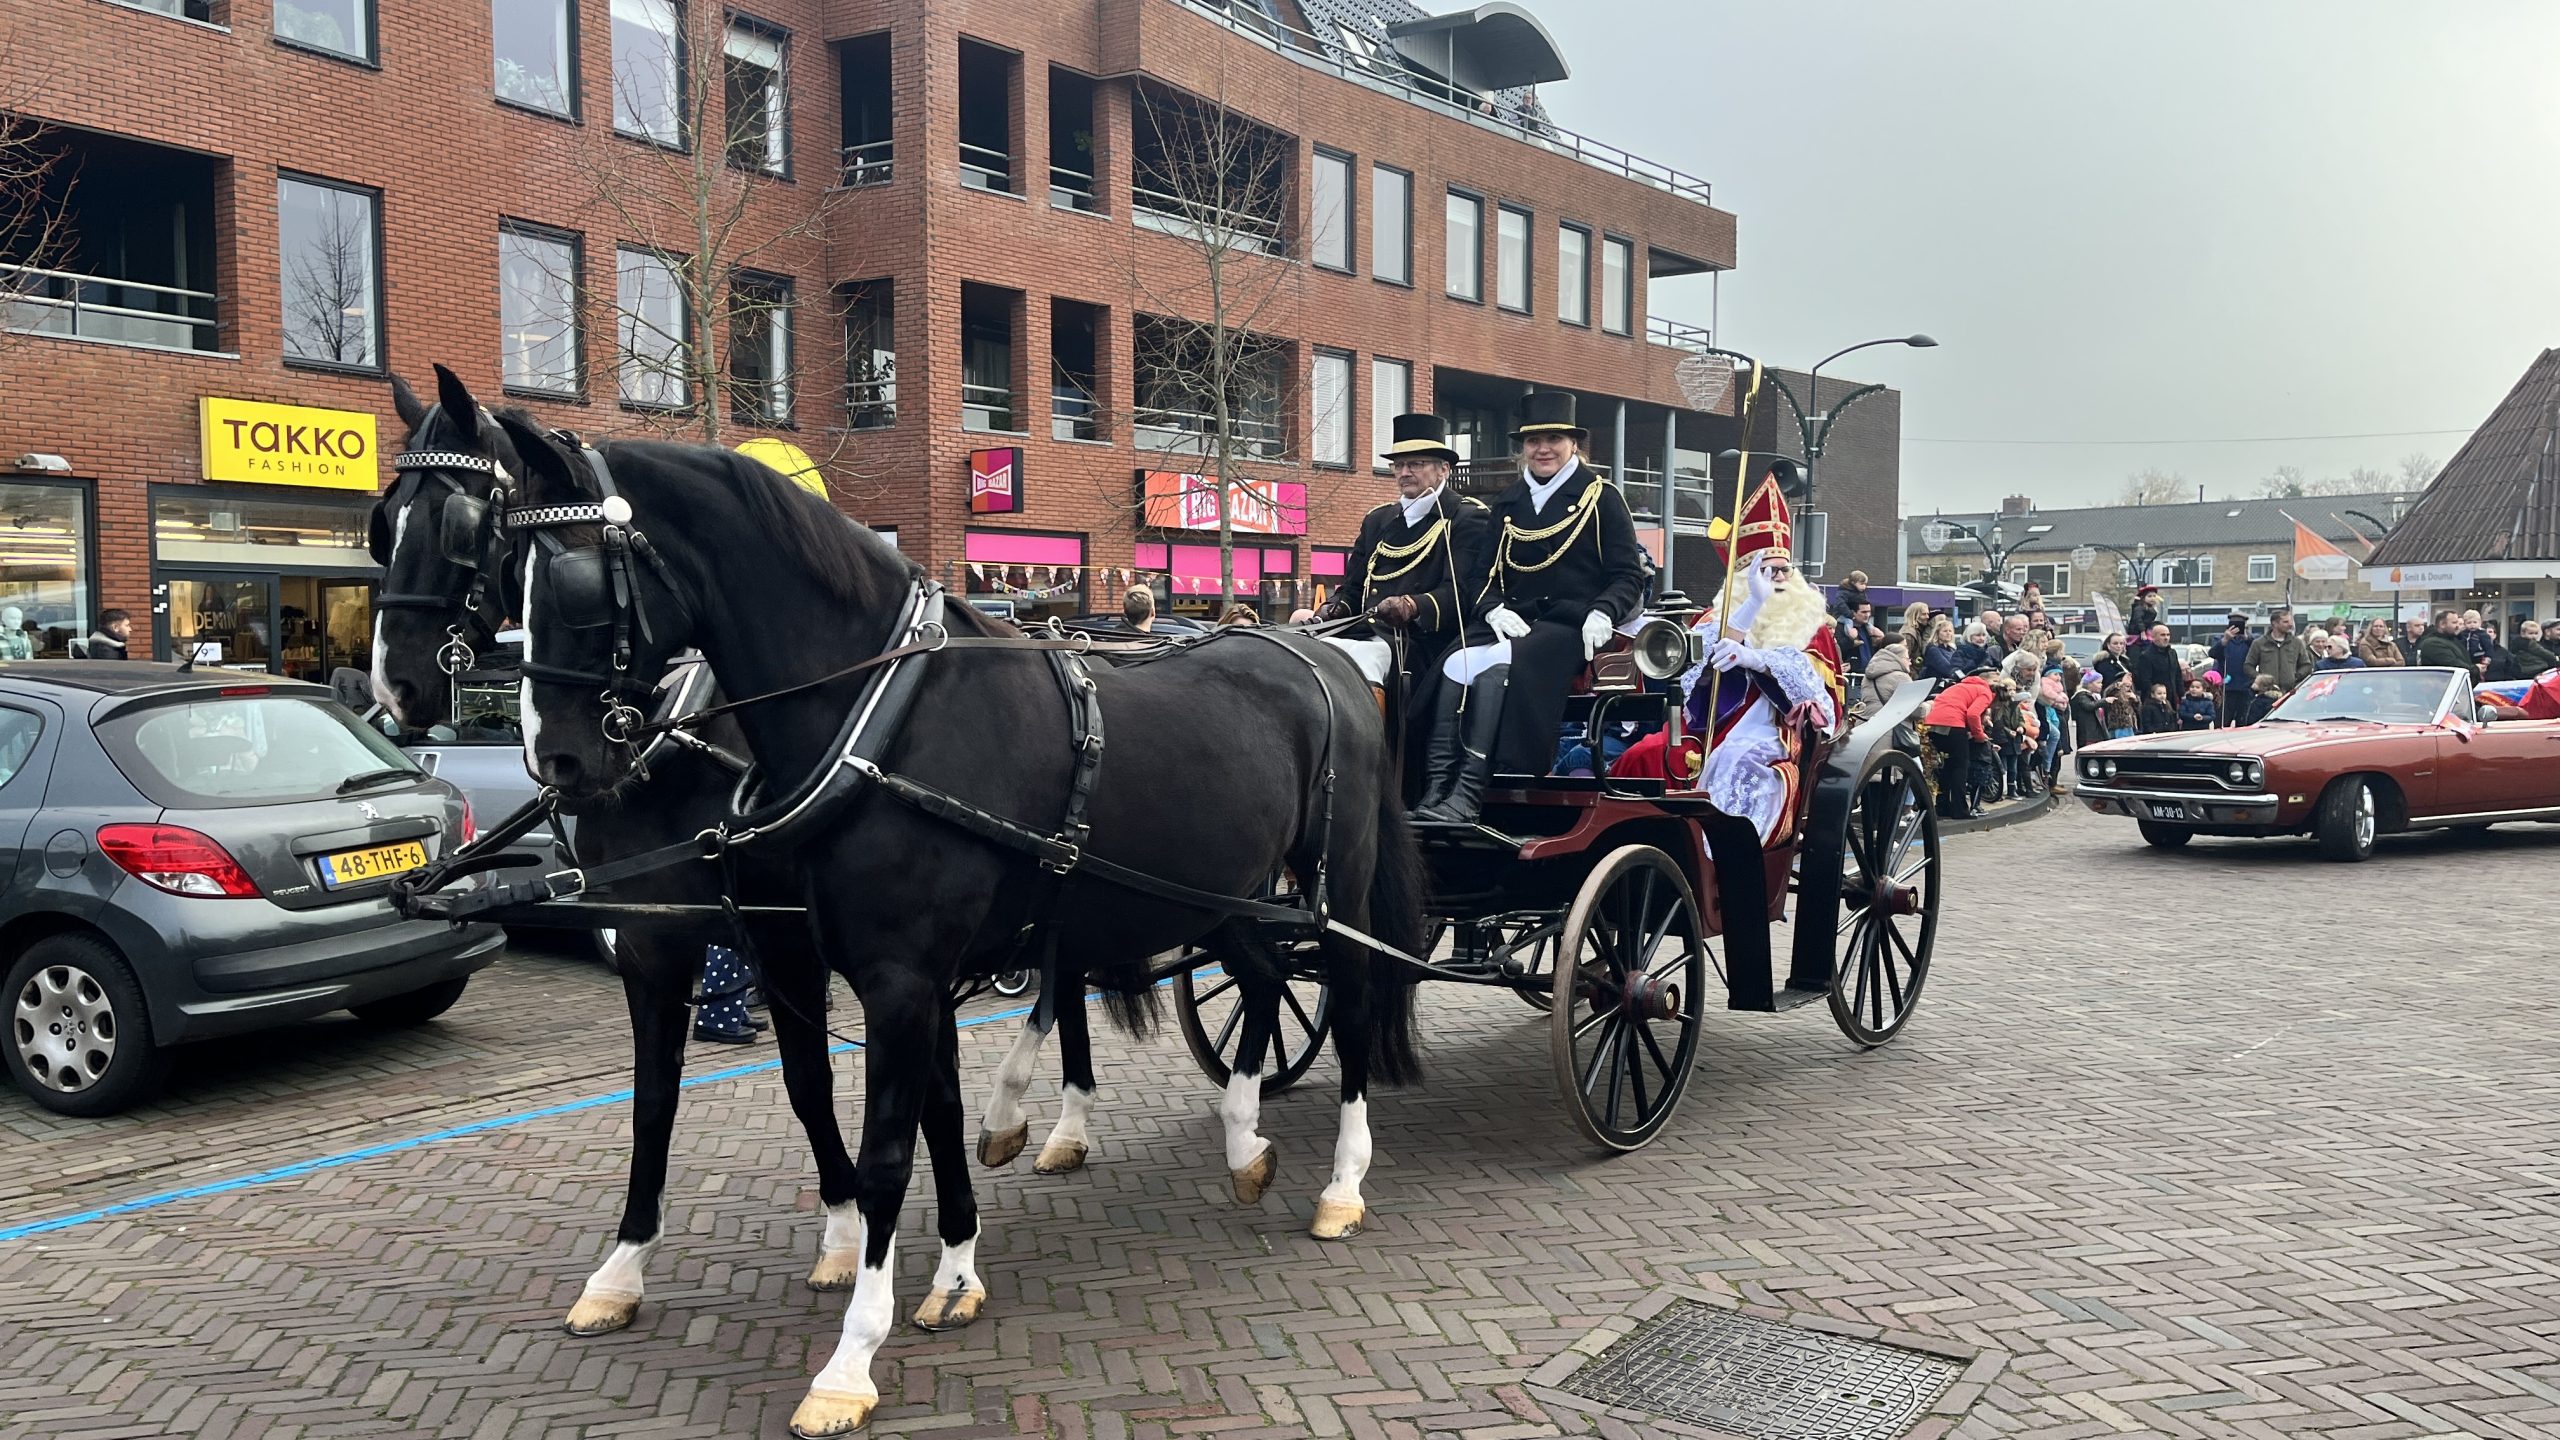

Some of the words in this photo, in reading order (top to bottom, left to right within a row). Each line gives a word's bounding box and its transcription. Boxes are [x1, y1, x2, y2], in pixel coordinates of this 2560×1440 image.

[248, 458, 345, 476] FASHION
[976, 477, 987, 491] BIG
[988, 472, 1008, 489] BAZAR
[1191, 486, 1216, 520] BIG
[1228, 484, 1268, 527] AZAR
[2404, 573, 2419, 582] Smit
[2421, 572, 2426, 581] &
[2428, 572, 2453, 581] Douma
[340, 846, 421, 877] 48-THF-6
[272, 884, 311, 897] PEUGEOT
